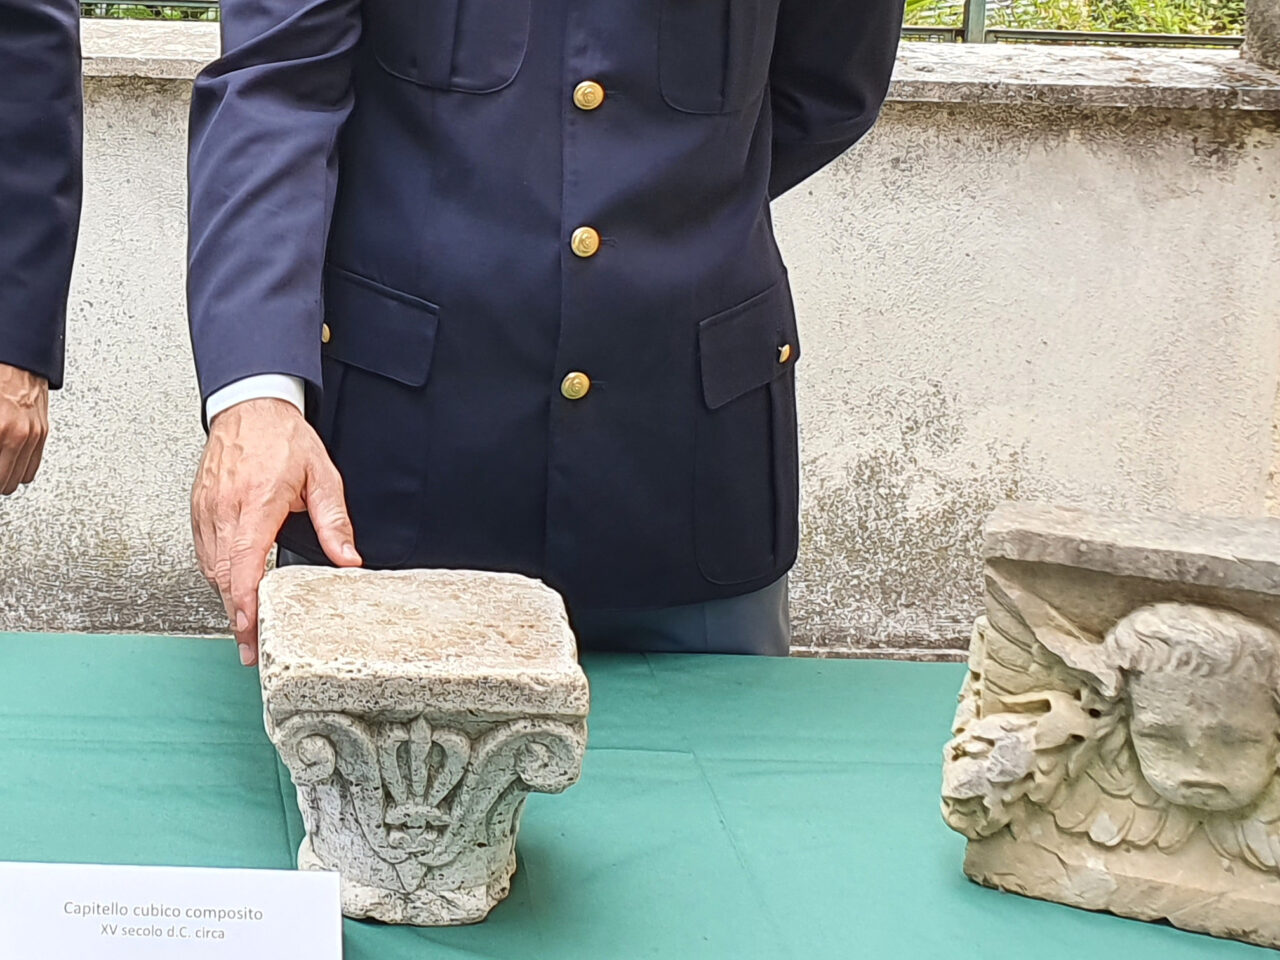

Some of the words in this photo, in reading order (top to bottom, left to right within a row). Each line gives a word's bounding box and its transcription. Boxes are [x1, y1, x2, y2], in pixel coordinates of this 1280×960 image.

[63, 901, 129, 918] Capitello
[132, 903, 181, 918] cubico
[185, 906, 264, 923] composito
[100, 923, 118, 936] XV
[121, 924, 163, 938] secolo
[166, 925, 191, 938] d.C.
[195, 926, 225, 940] circa
